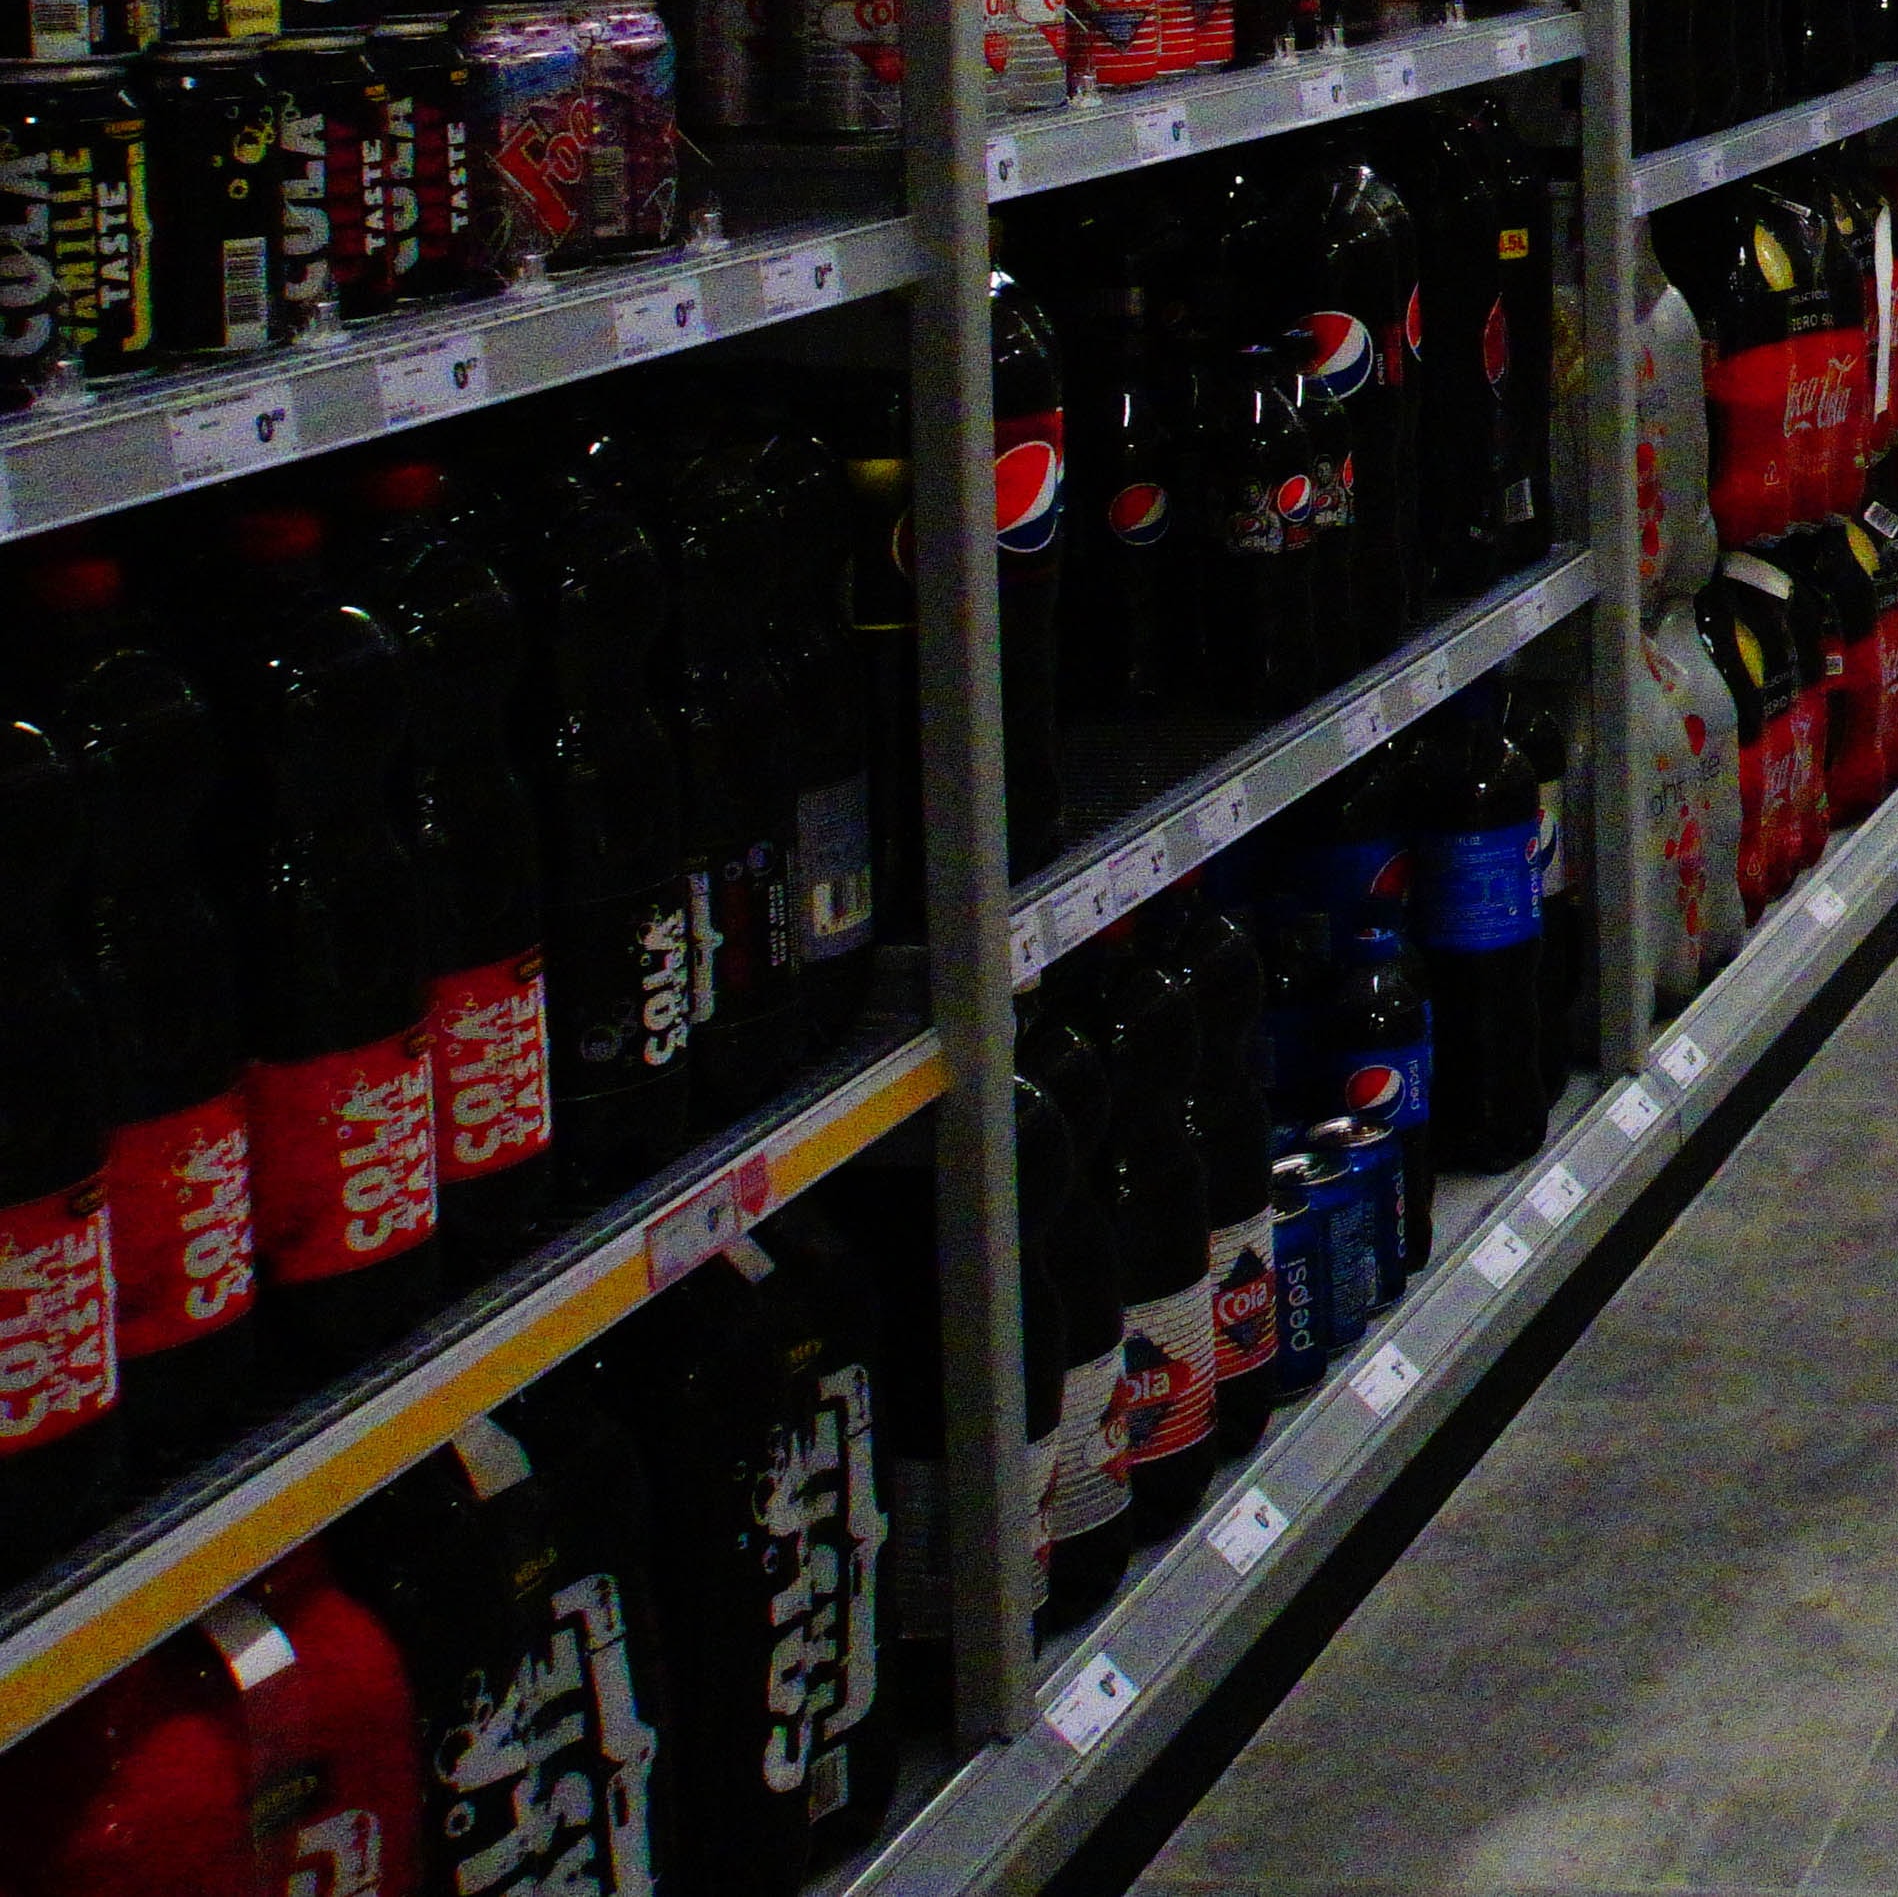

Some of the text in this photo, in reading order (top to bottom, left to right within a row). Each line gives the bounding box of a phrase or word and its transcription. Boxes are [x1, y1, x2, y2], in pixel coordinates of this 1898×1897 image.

[361, 137, 387, 257] TASTE
[446, 120, 471, 235] TASTE
[97, 179, 131, 310] TASTE
[446, 1007, 504, 1165] COLA
[1217, 1276, 1270, 1322] Cola
[1285, 1255, 1310, 1353] pepsi
